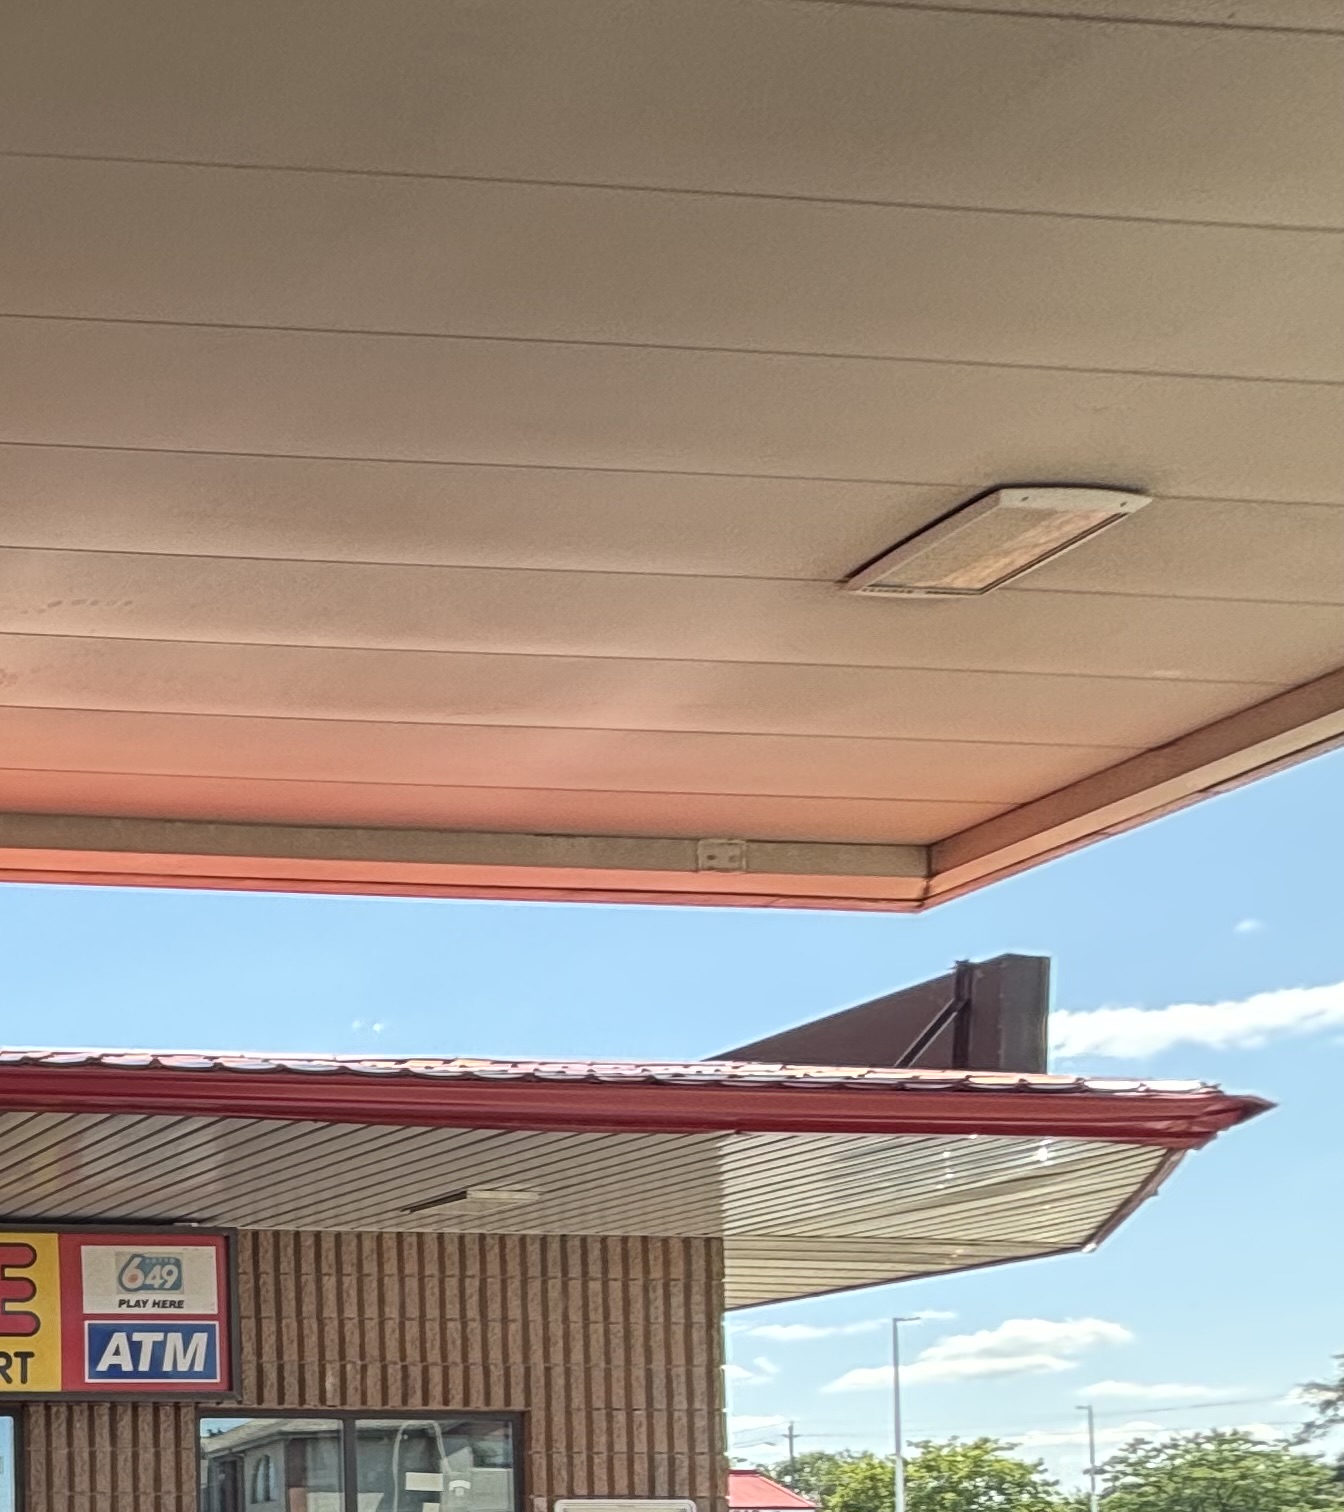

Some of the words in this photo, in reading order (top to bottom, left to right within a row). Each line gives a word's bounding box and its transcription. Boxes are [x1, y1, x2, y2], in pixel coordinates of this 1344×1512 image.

[118, 1299, 149, 1309] PLAY
[152, 1299, 184, 1309] HERE
[96, 1331, 208, 1372] ATM
